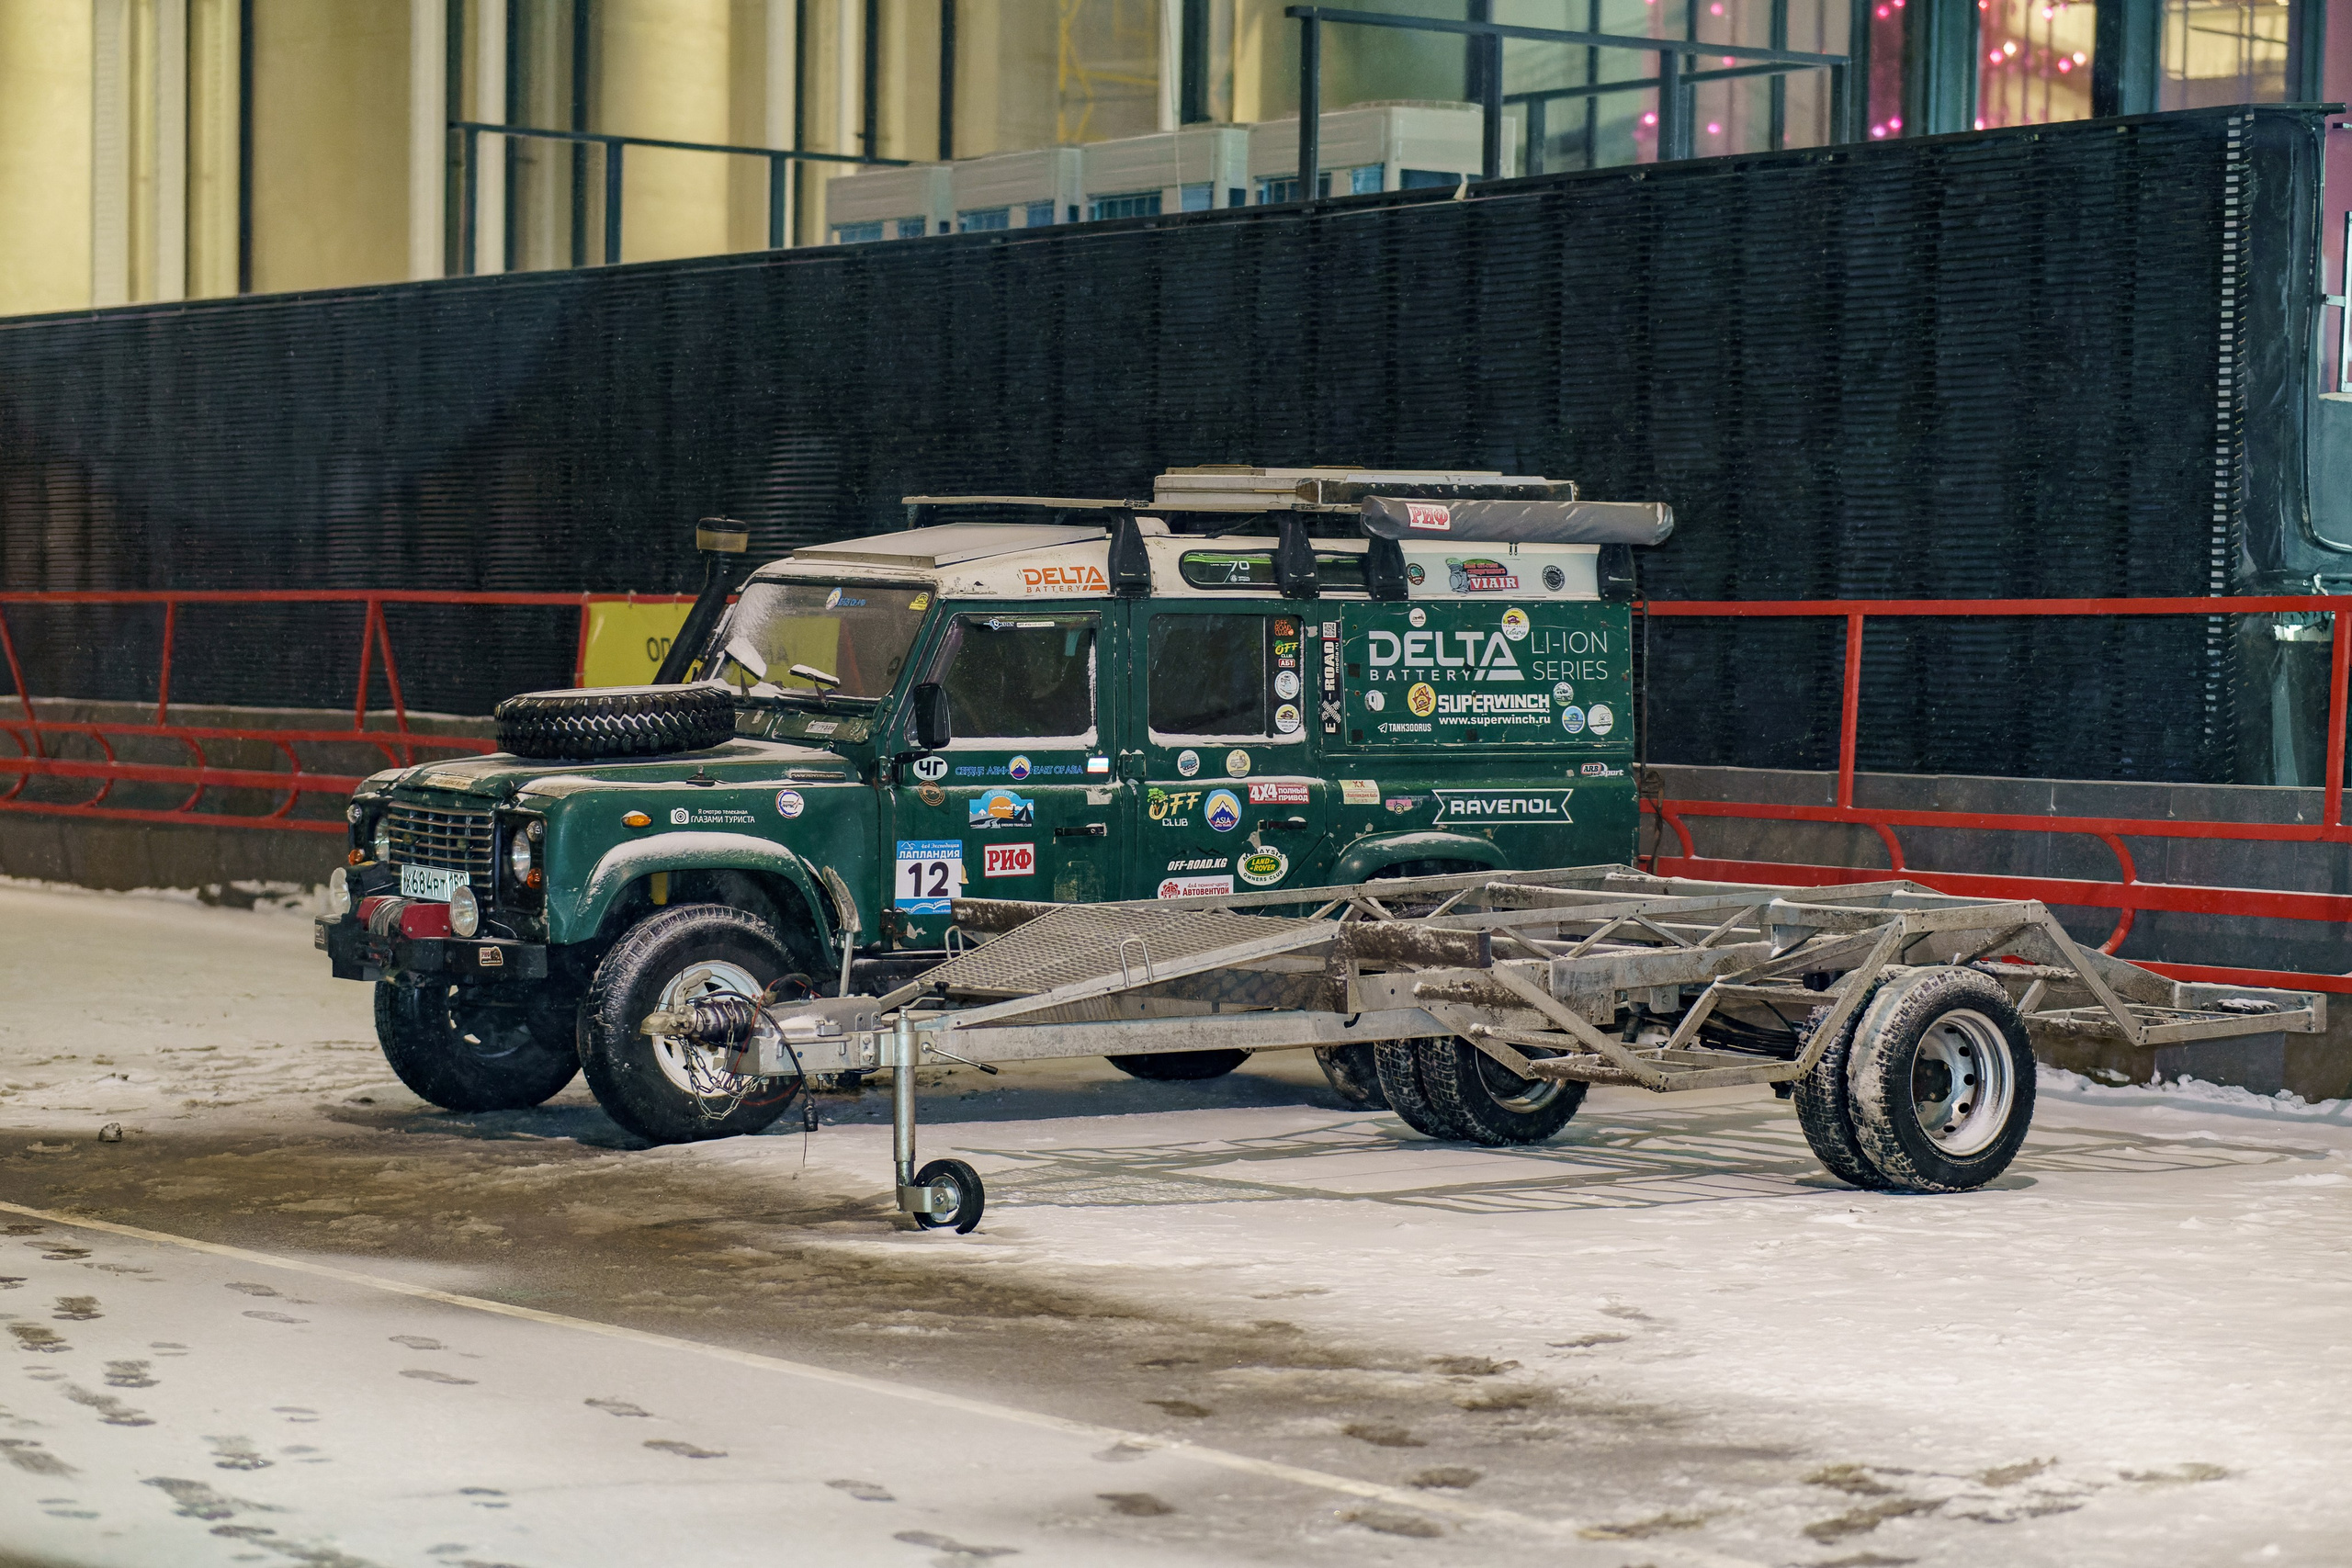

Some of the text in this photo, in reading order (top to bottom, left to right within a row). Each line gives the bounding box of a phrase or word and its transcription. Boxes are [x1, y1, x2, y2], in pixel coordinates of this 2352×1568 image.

[1409, 506, 1449, 525] РИФ
[1229, 561, 1250, 571] 70
[1023, 566, 1106, 585] DELTA
[1026, 585, 1081, 593] BATTERY
[1470, 578, 1517, 589] VIAIR
[1274, 642, 1299, 655] OFF
[1368, 630, 1519, 667] DELTA
[1531, 631, 1608, 654] LI-ION
[1369, 670, 1471, 682] BATTERY
[1532, 660, 1608, 681] SERIES
[1438, 694, 1550, 714] SUPERWINCH
[1388, 723, 1431, 732] TANK300RUS
[1439, 715, 1551, 727] www.superwinch.ru
[919, 761, 944, 775] ЧГ
[1064, 764, 1083, 774] ASIA
[1278, 786, 1307, 795] ПОЛНЫЙ
[1148, 791, 1202, 820] OFF
[1450, 798, 1557, 815] RAVENOL
[1162, 818, 1189, 827] CLUB
[1215, 816, 1231, 824] ASIA
[899, 850, 960, 859] ЛАПЛАНДИЯ
[988, 849, 1032, 871] РИФ
[1167, 858, 1228, 872] OFF-ROAD.KG
[908, 861, 949, 897] 12
[1243, 869, 1283, 882] OWNERS CLUB
